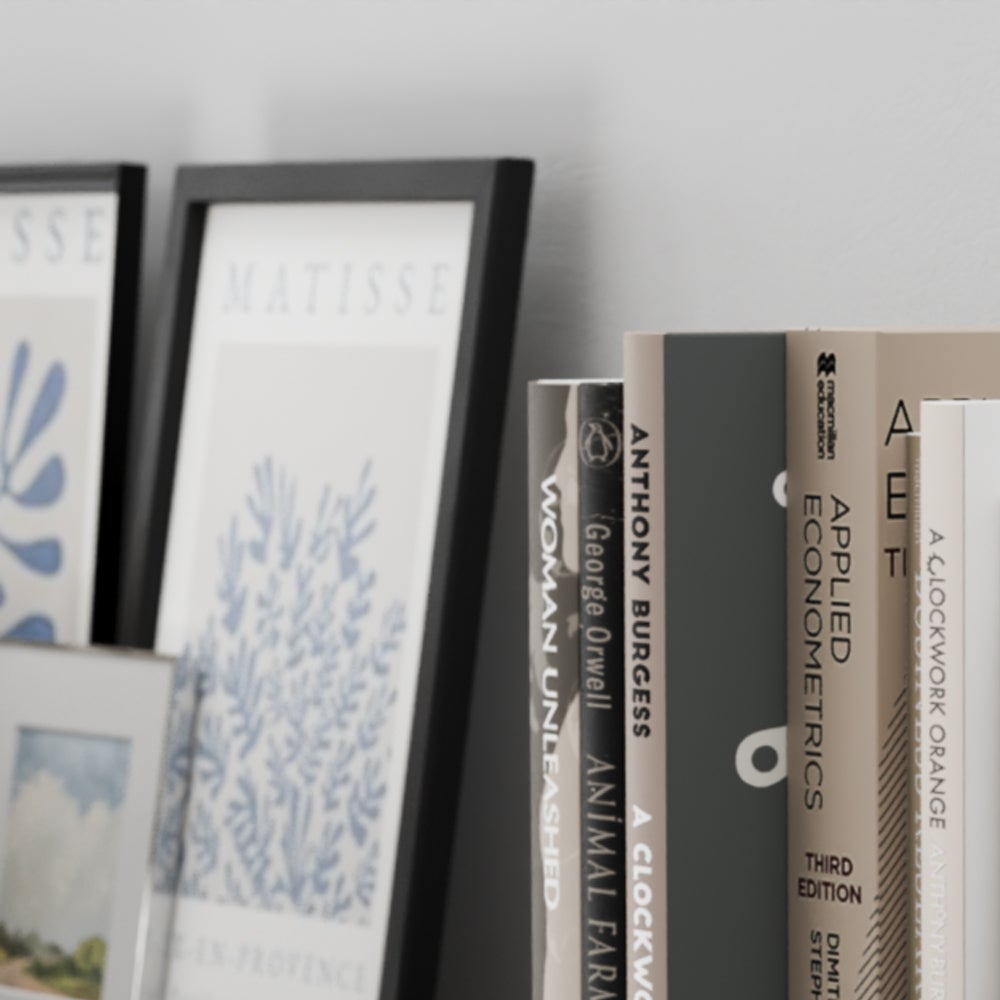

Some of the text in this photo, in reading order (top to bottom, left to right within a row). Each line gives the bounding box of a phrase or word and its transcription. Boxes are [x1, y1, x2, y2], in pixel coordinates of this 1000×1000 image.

[221, 260, 453, 317] MATISSE
[816, 380, 826, 461] education
[827, 380, 838, 461] macmillan
[631, 424, 651, 586] ANTHONY
[928, 528, 945, 547] A
[581, 523, 612, 617] George
[830, 494, 852, 663] APPLIED
[586, 626, 612, 709] Orwell
[631, 600, 651, 738] BURGESS
[803, 494, 823, 811] ECONOMETRICS
[926, 551, 947, 717] CLOCKWORK
[540, 474, 561, 912] WOMAN UNLEASHED
[632, 804, 653, 829] A
[928, 723, 947, 830] ORANGE
[797, 877, 862, 905] EDITION
[804, 851, 854, 877] THIRD
[929, 842, 948, 953] ANTHONY
